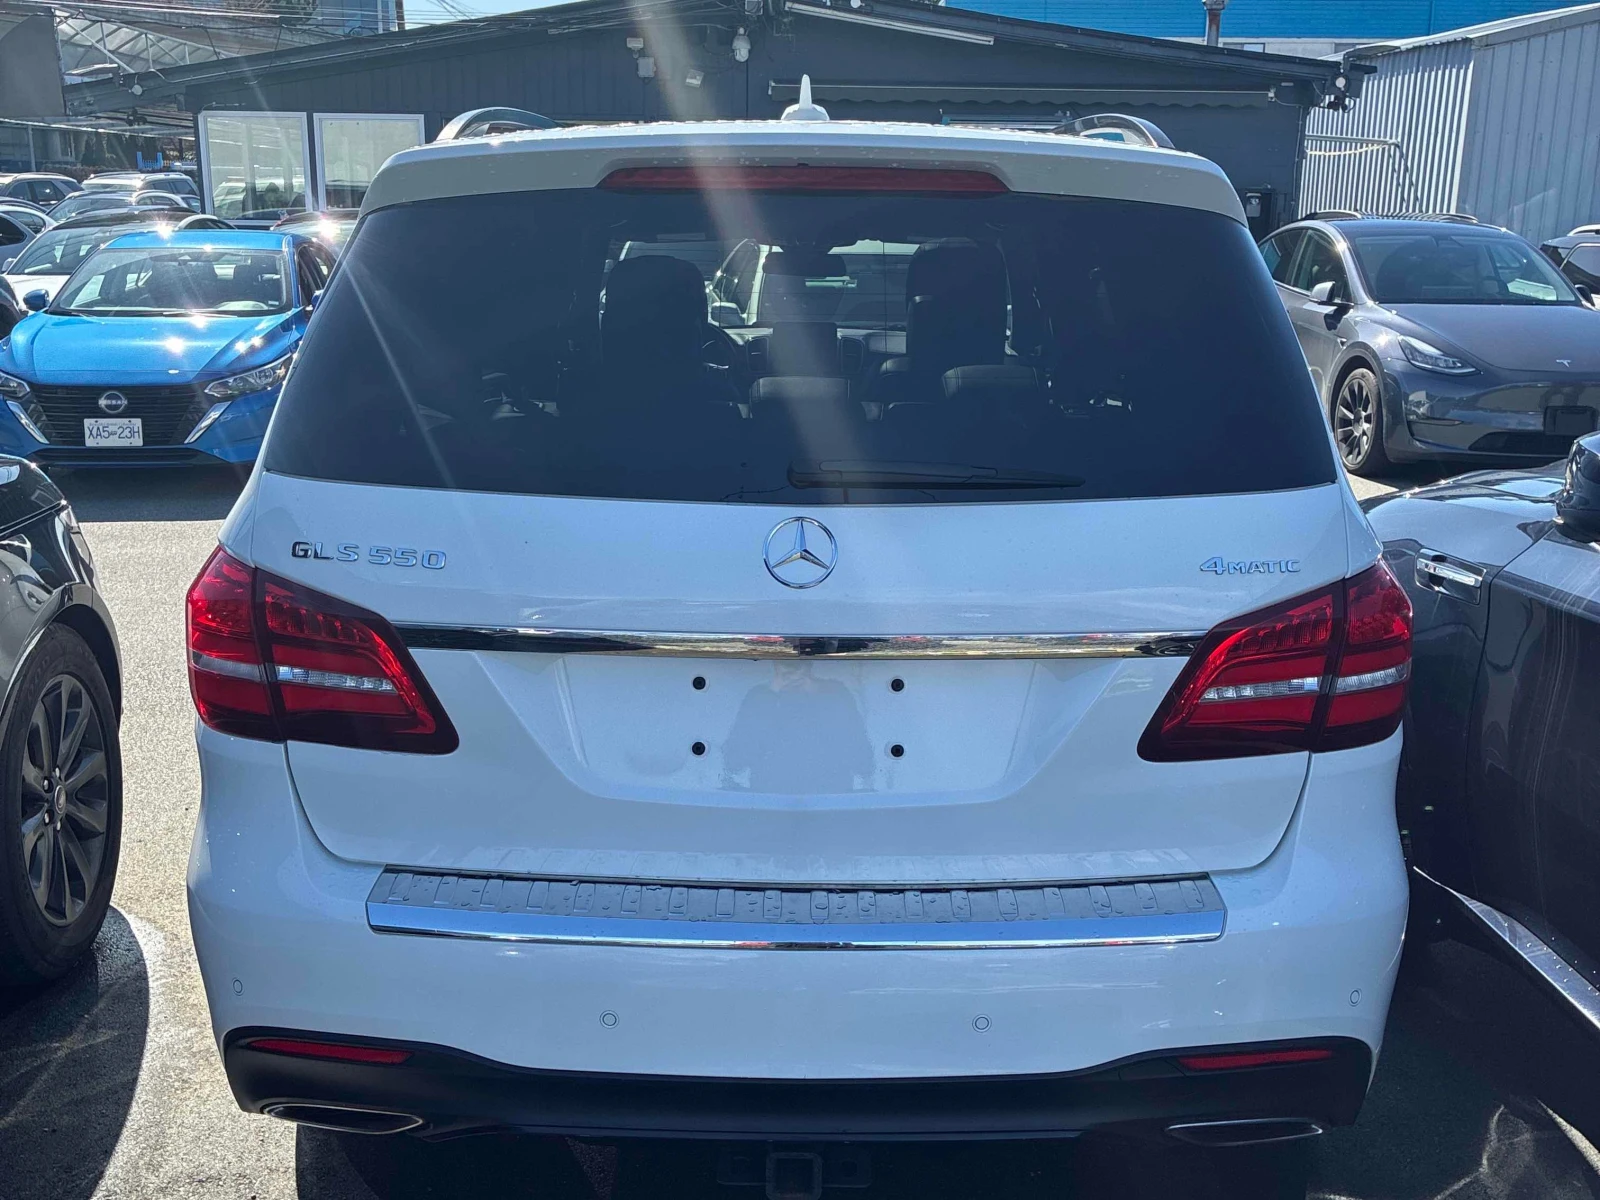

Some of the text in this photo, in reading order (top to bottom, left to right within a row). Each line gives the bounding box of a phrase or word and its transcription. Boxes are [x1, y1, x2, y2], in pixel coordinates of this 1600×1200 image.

[291, 541, 447, 570] GLS 550
[1200, 556, 1301, 575] 4MATIC
